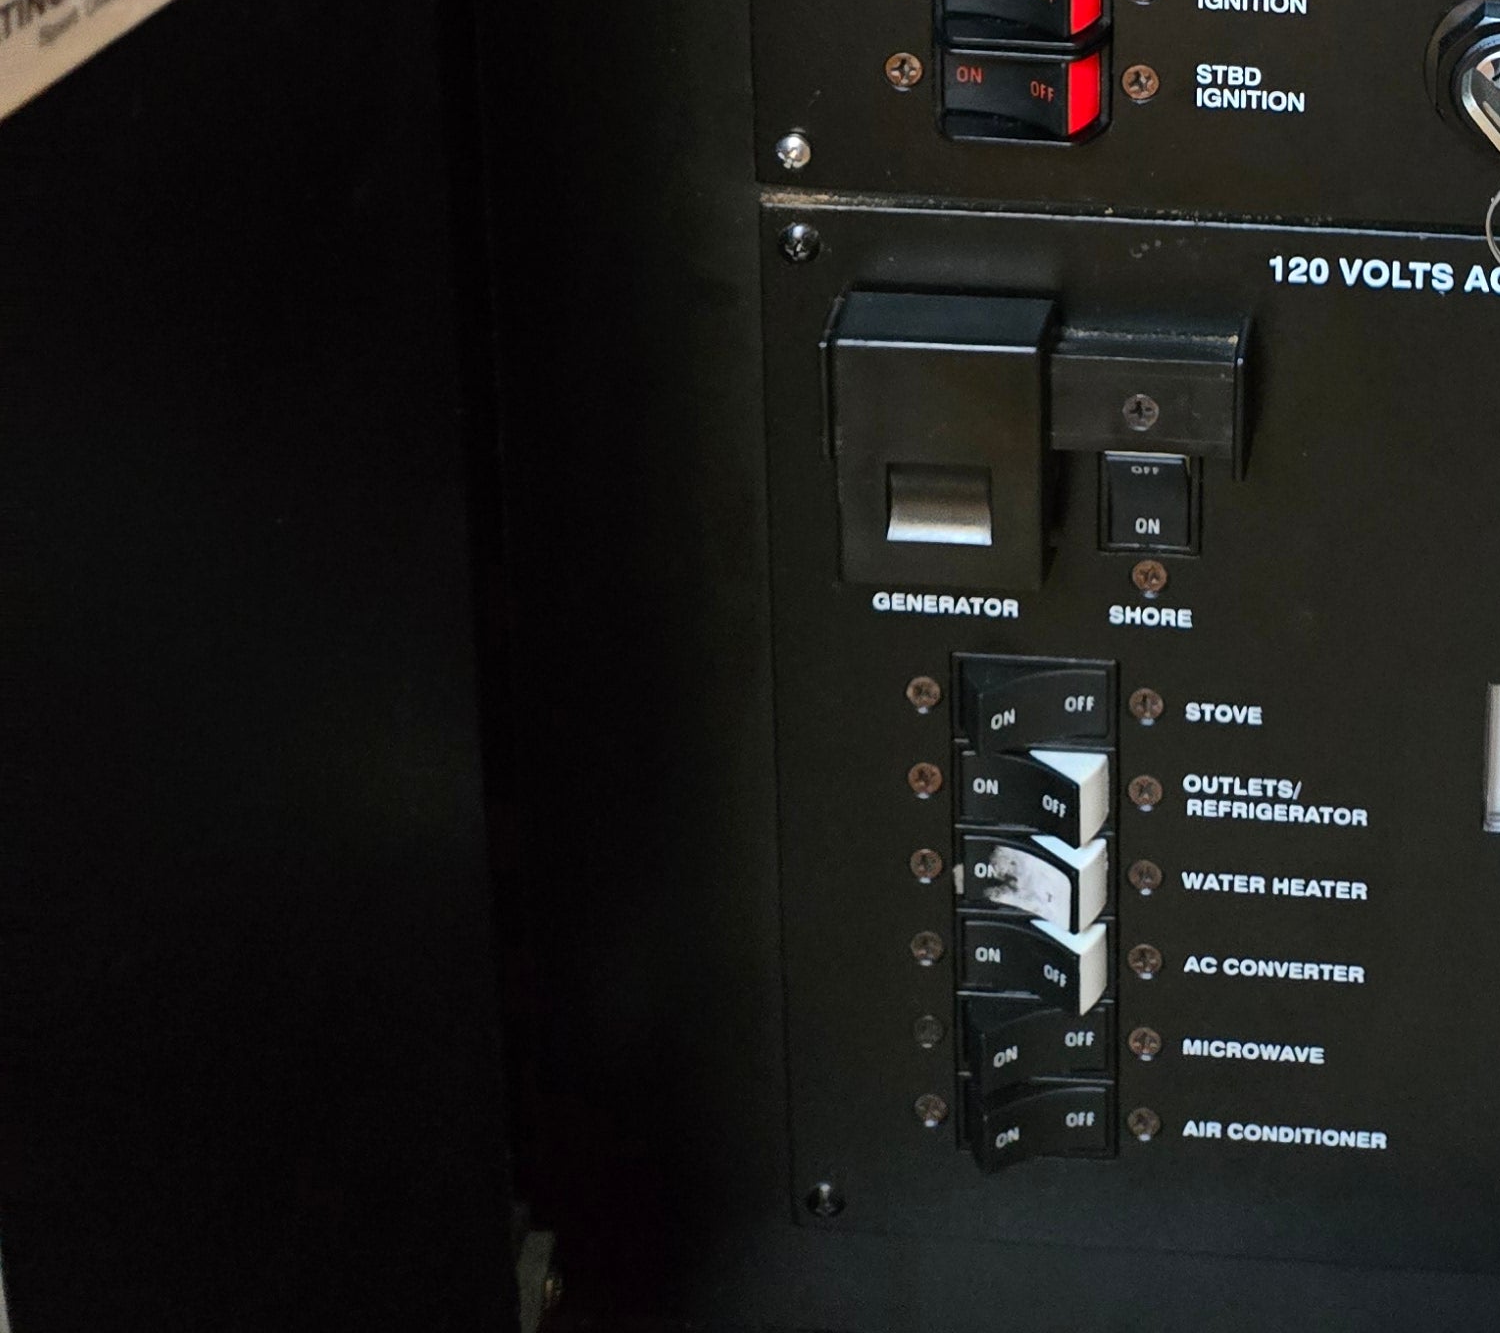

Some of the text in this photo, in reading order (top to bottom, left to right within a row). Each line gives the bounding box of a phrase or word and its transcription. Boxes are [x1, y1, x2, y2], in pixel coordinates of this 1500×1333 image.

[1196, 65, 1262, 87] STBD
[1196, 89, 1305, 113] IGNITION
[1269, 256, 1330, 284] 120
[1338, 258, 1455, 291] VOLTS
[1135, 517, 1161, 534] ON
[872, 592, 1019, 618] GENERATOR
[1109, 605, 1193, 628] SHORE
[1185, 702, 1263, 726] STOVE
[972, 778, 999, 795] ON
[1182, 774, 1303, 800] OUTLETS/
[1042, 794, 1067, 818] OFF
[1186, 799, 1368, 827] REFRIGERATOR
[1181, 871, 1368, 900] WATER HEATER
[1183, 956, 1365, 984] AC CONVERTER
[1182, 1038, 1325, 1064] MICROWAVE
[1182, 1120, 1387, 1149] AIR CONDITIONER
